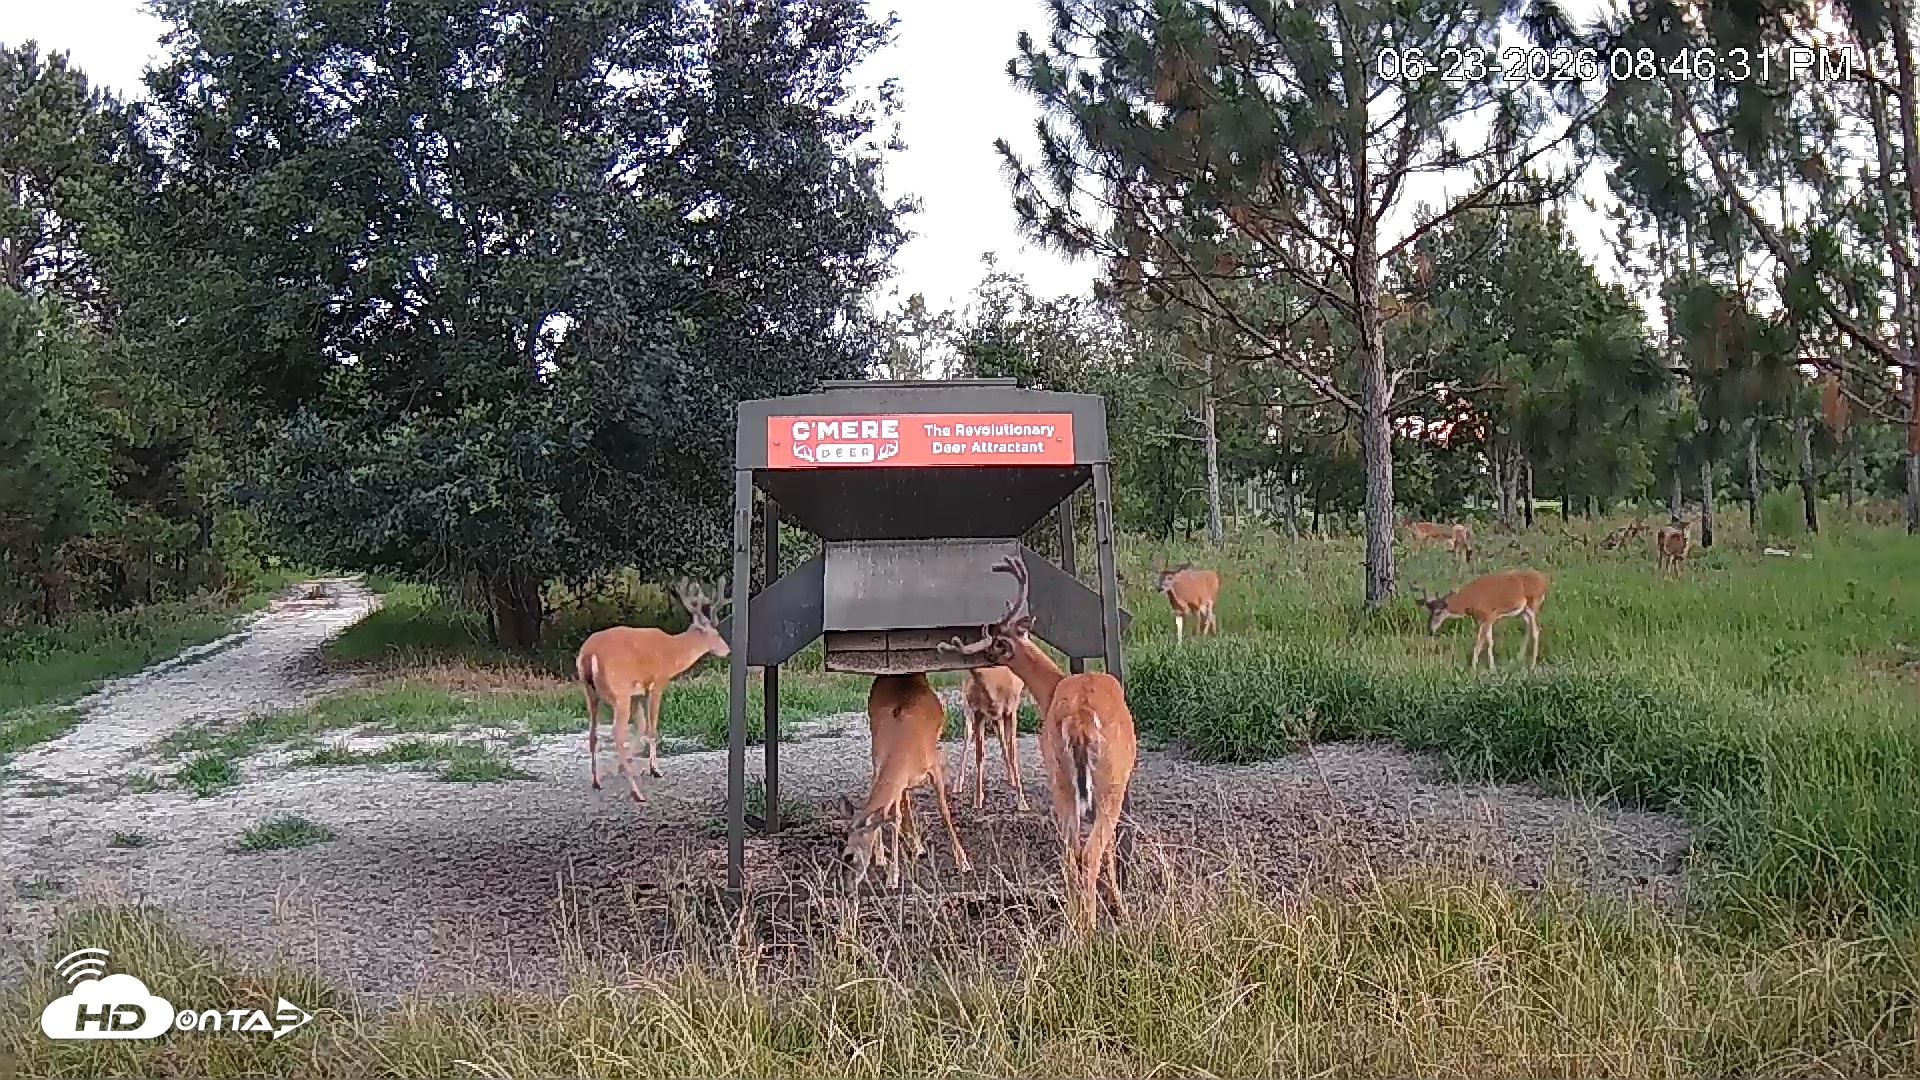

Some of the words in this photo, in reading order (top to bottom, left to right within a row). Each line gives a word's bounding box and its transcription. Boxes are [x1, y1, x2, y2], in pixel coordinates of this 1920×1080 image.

[791, 419, 900, 440] C'MERE
[923, 424, 951, 437] The
[955, 423, 1055, 438] Revolutionary
[931, 441, 967, 455] Deer
[971, 440, 1045, 454] Attractant
